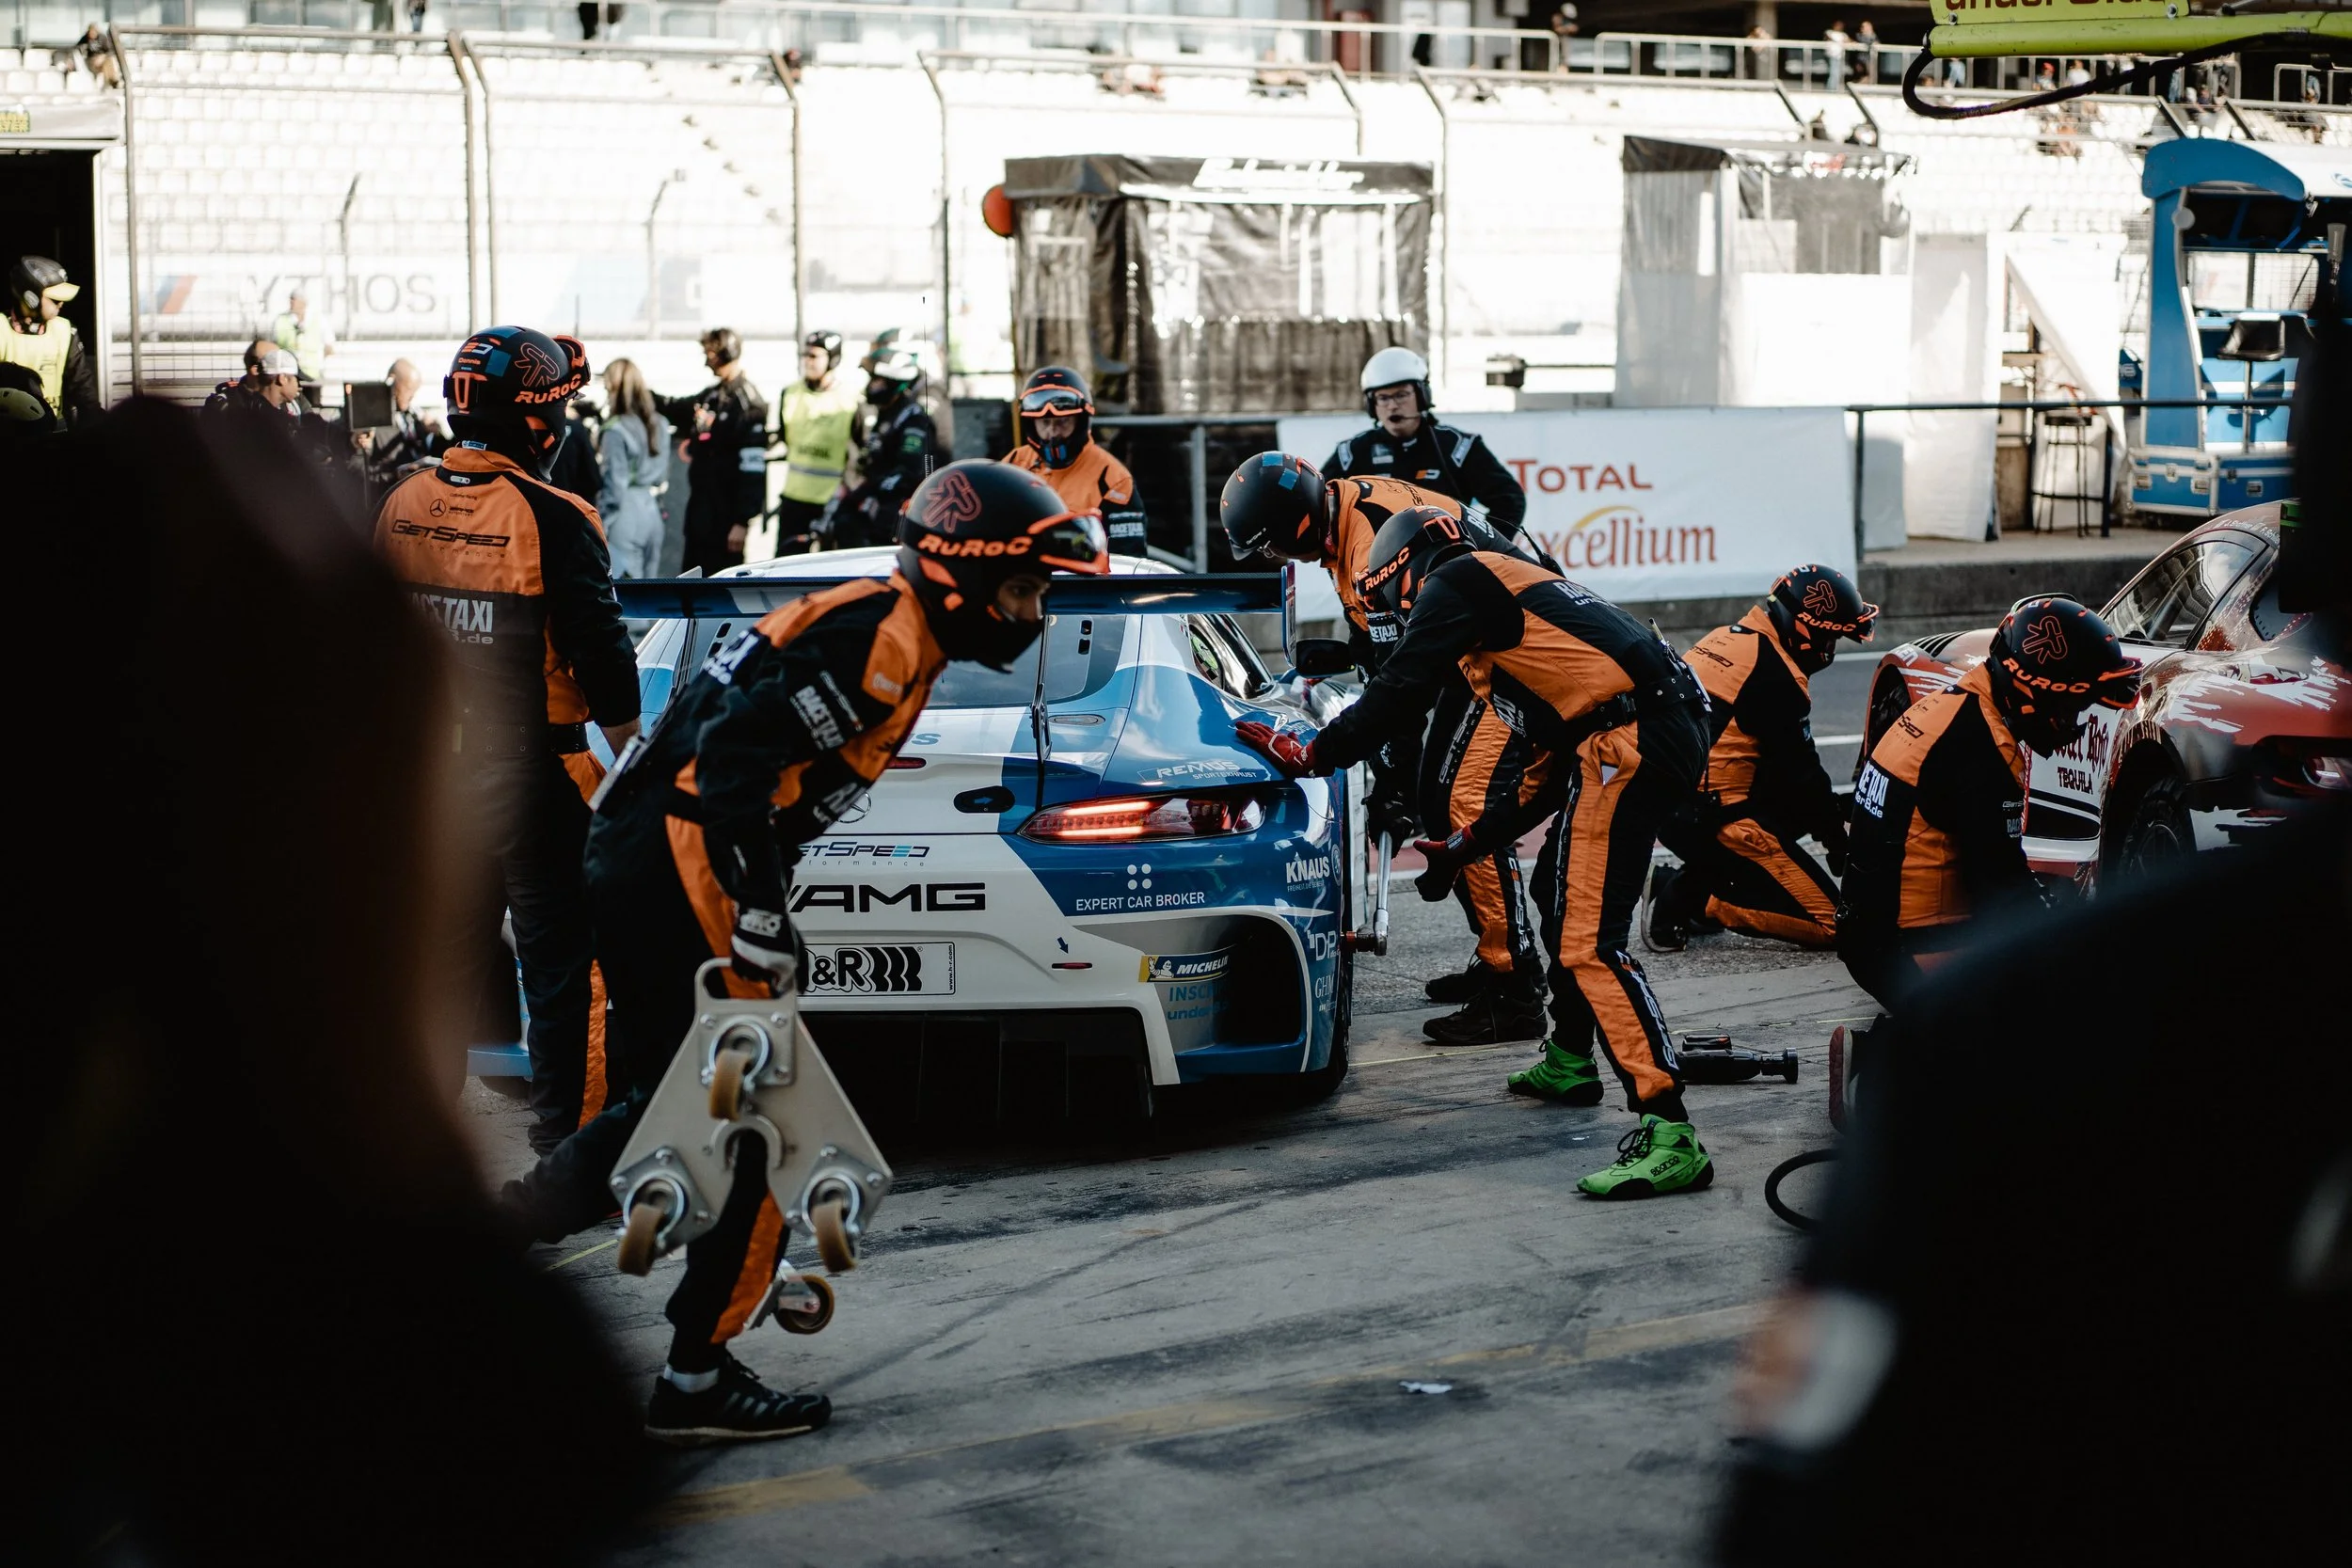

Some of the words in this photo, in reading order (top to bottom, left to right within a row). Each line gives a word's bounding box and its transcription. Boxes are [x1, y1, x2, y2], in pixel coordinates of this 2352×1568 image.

[1507, 459, 1653, 494] TOTAL
[1156, 759, 1241, 779] REMUS
[2057, 766, 2093, 795] TEQUILA
[1286, 856, 1329, 883] KNAUS
[789, 882, 986, 912] AMG
[1076, 897, 1124, 911] EXPERT
[1127, 895, 1152, 909] CAR
[1155, 892, 1205, 907] BROKER
